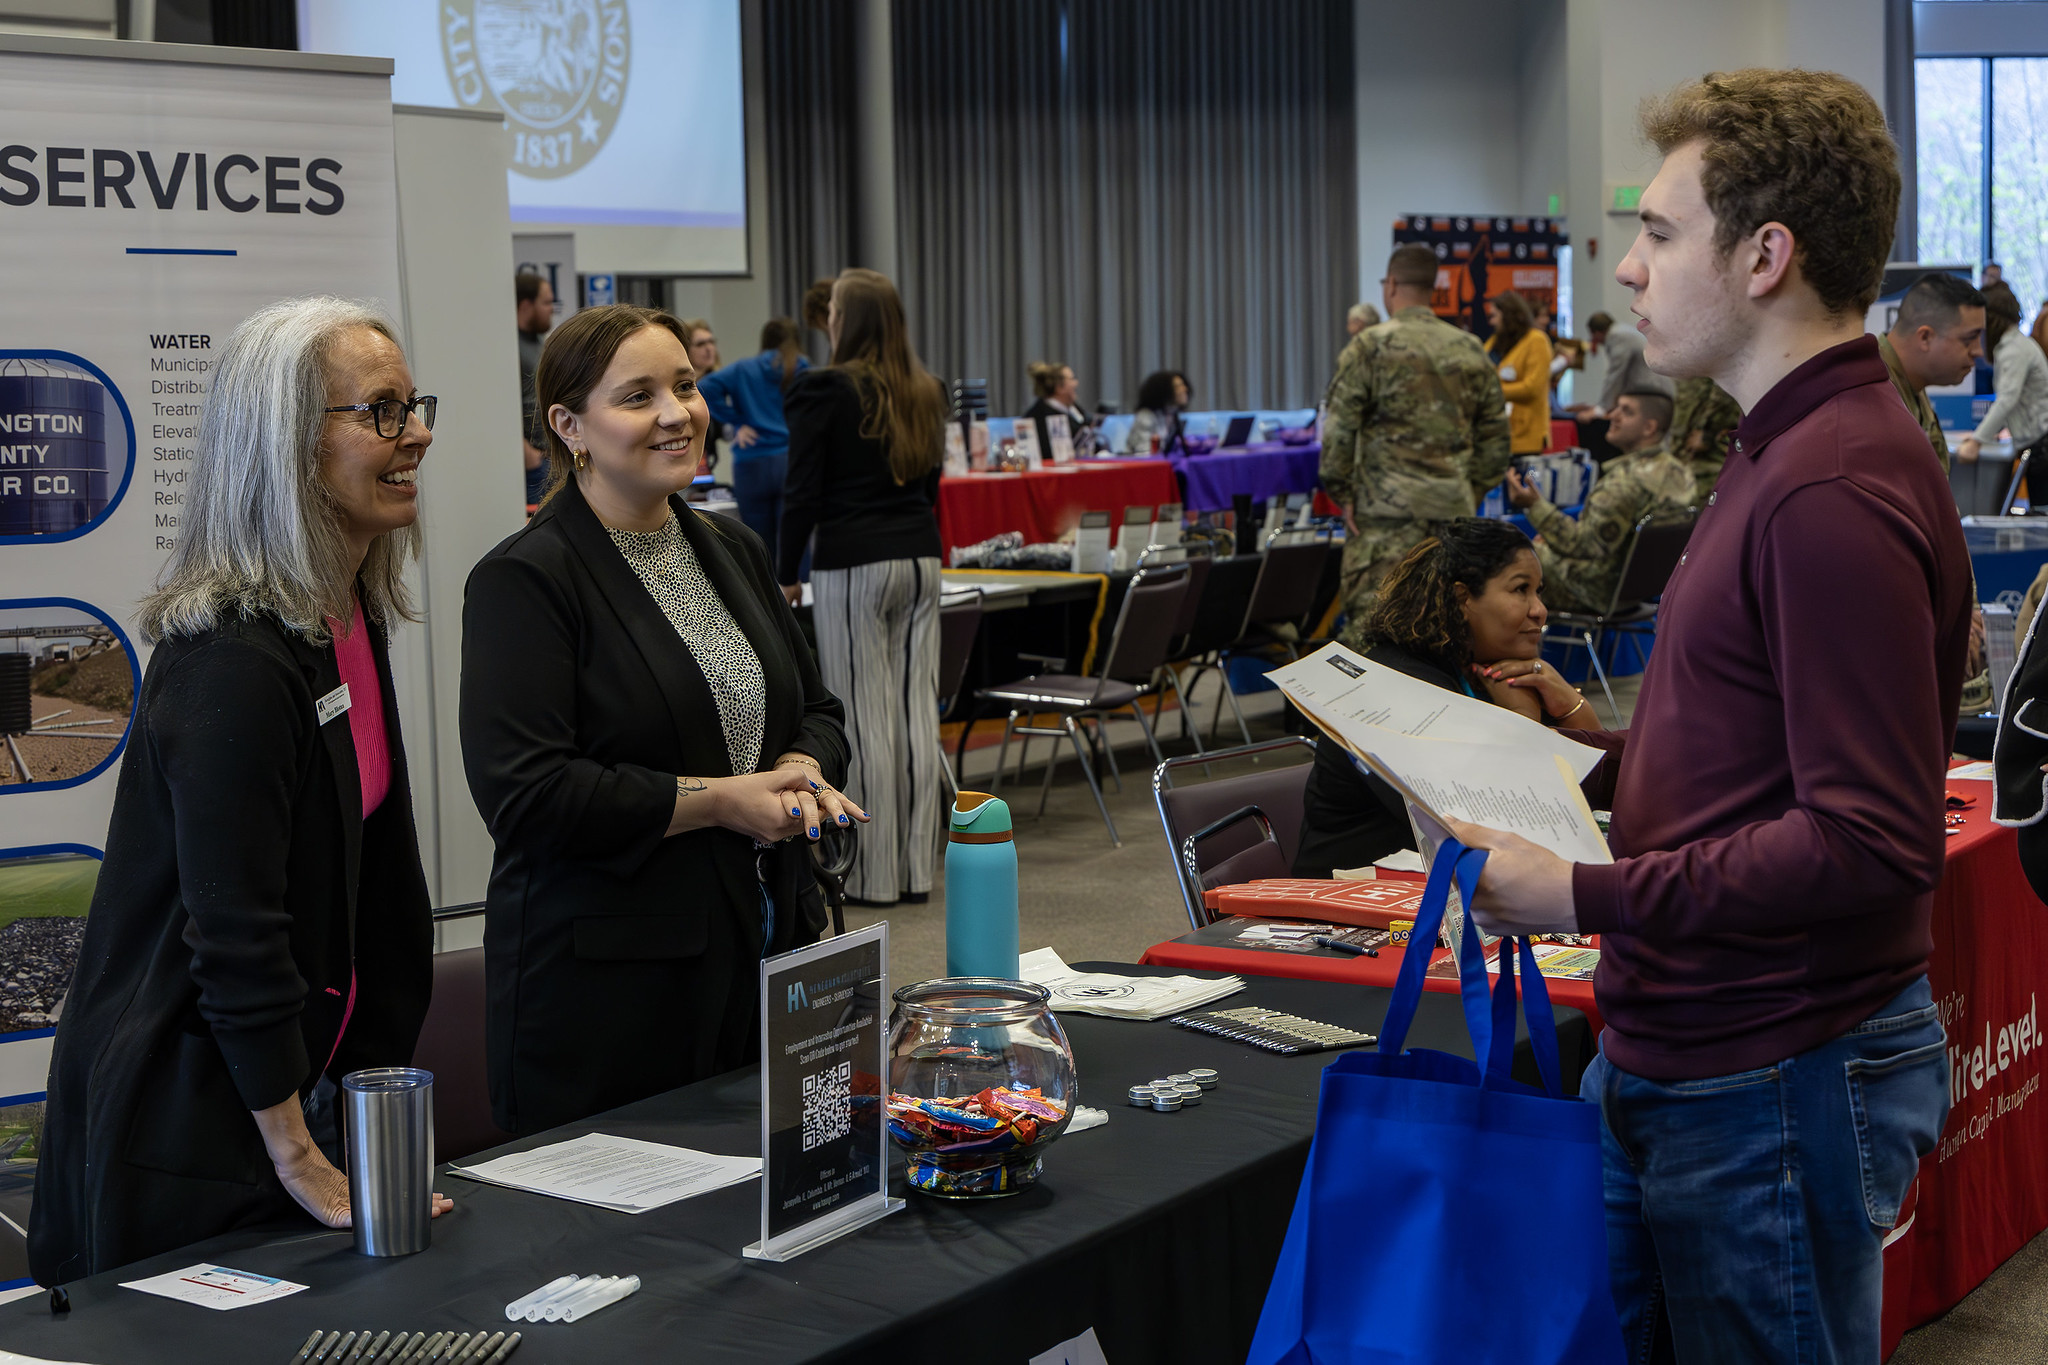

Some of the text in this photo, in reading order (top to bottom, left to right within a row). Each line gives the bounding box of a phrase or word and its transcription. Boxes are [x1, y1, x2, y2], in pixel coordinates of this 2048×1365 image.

[446, 5, 483, 106] CITY
[597, 1, 626, 107] NOIS
[513, 130, 573, 169] 1837
[0, 144, 345, 216] SERVICES
[150, 334, 211, 350] WATER
[0, 444, 50, 465] NTY
[0, 475, 76, 496] R CO.
[1348, 886, 1410, 901] Hi
[1392, 930, 1411, 941] DO
[1937, 990, 1965, 1029] We're
[1969, 1096, 1994, 1141] Capil
